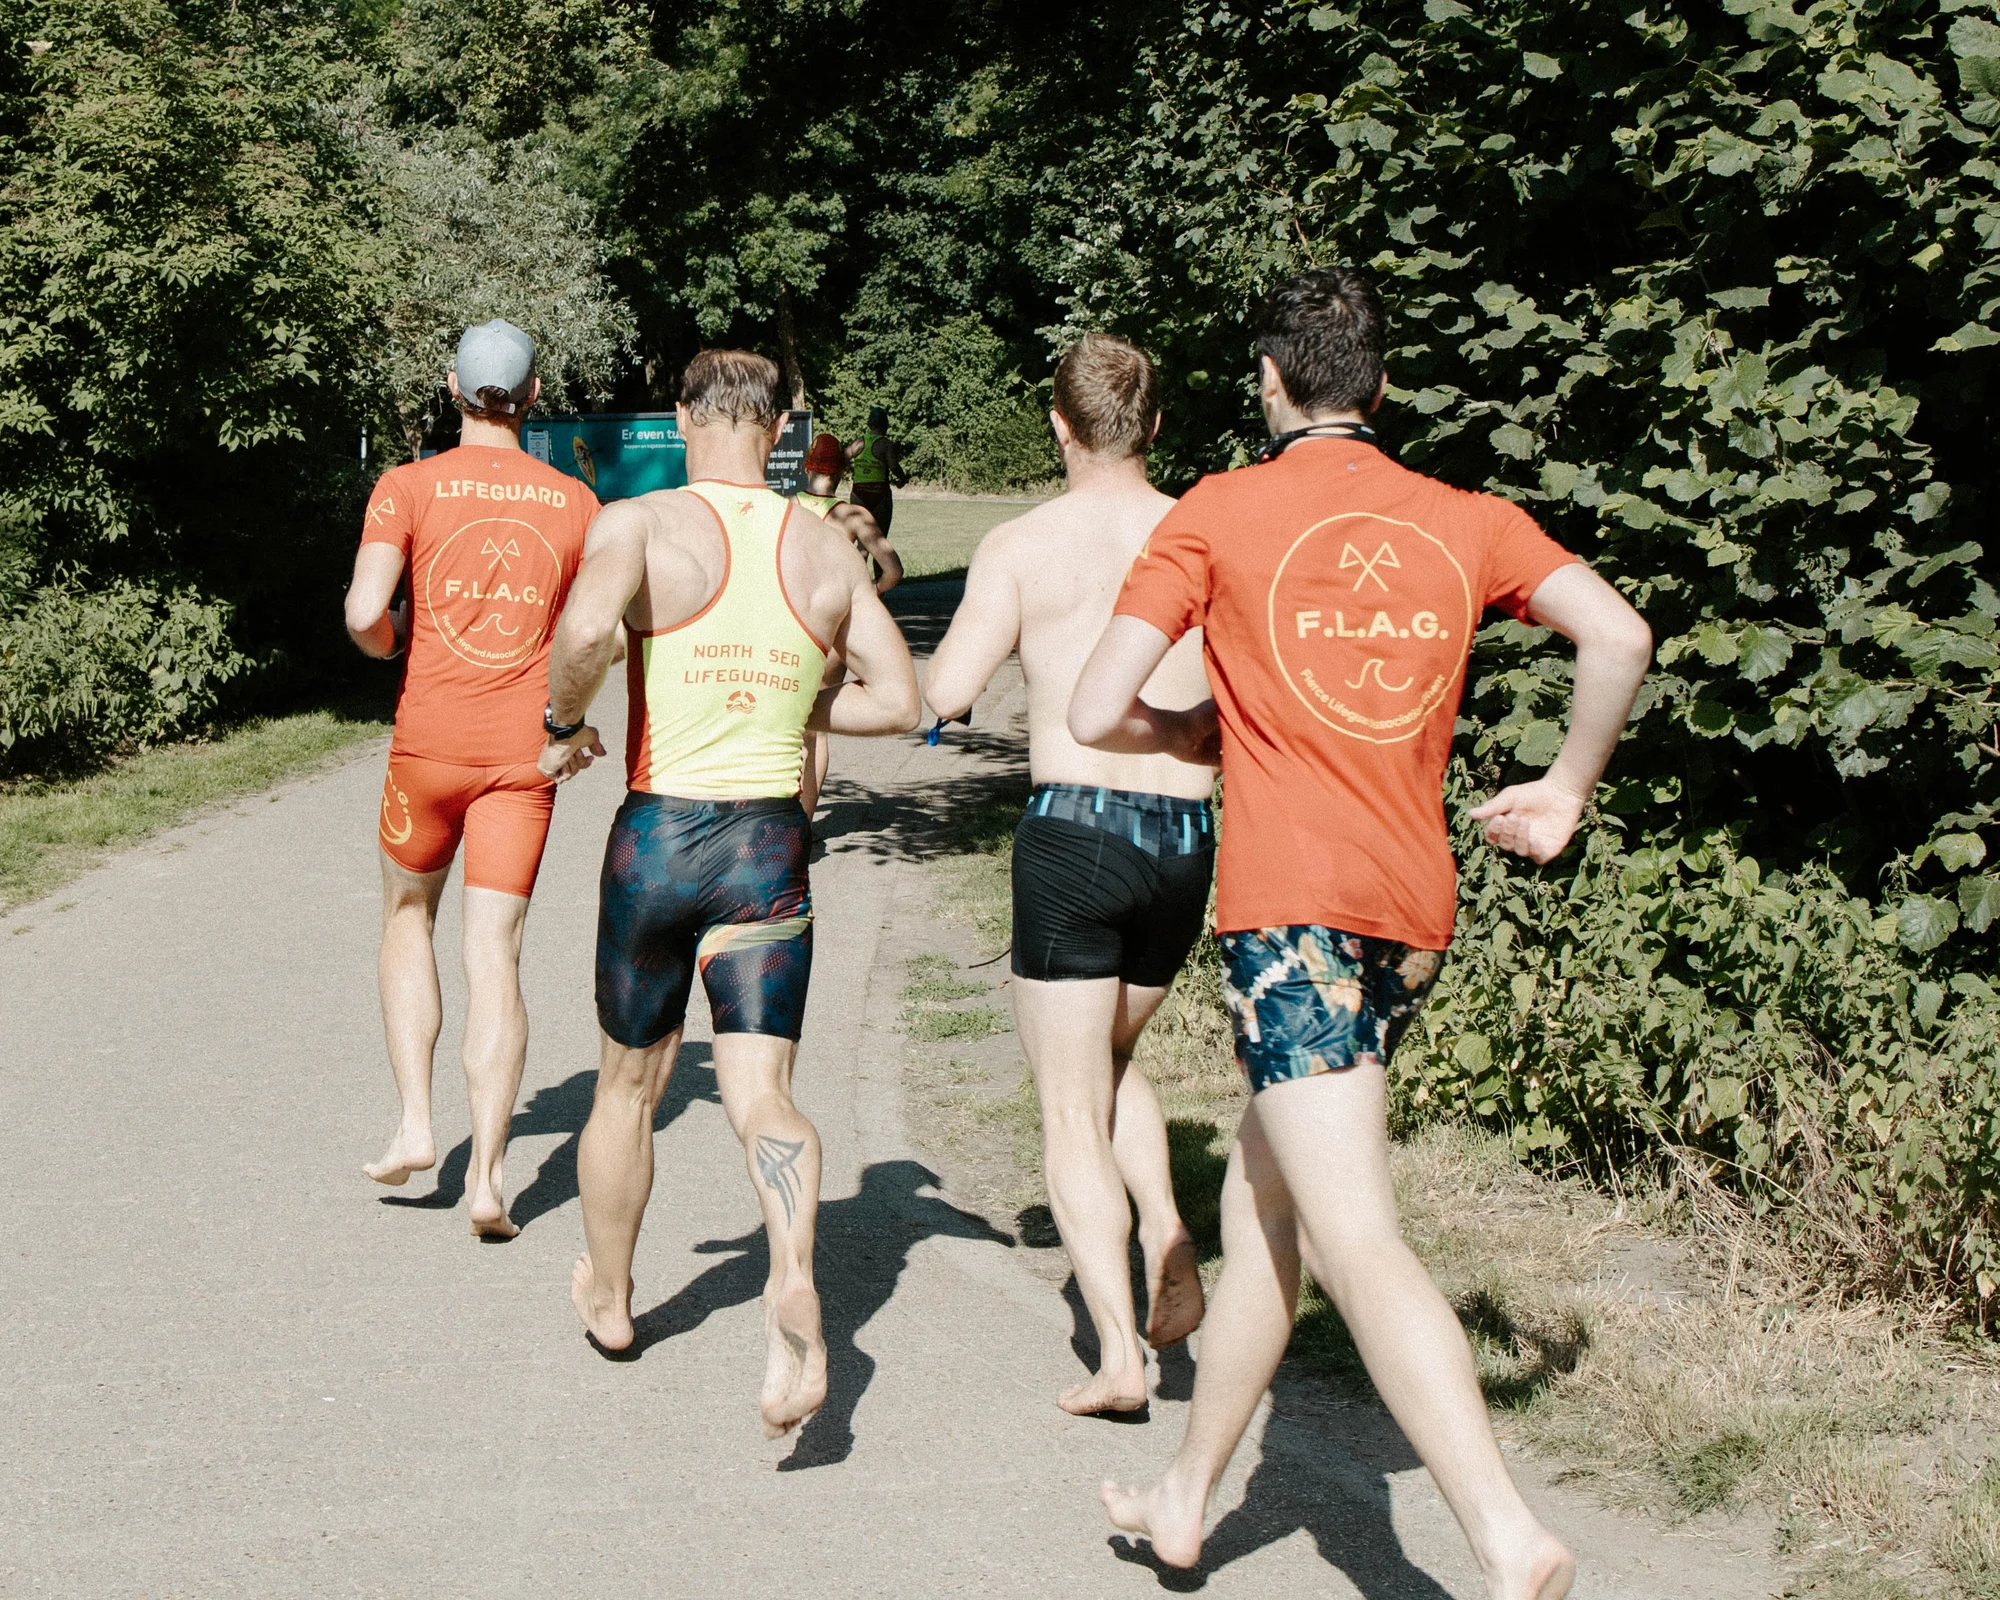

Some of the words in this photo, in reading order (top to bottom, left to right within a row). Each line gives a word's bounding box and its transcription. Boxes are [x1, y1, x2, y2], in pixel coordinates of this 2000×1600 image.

[621, 429, 634, 440] Er
[636, 430, 664, 440] even
[435, 479, 566, 509] LIFEGUARD
[445, 580, 545, 606] F.L.A.G.
[1296, 610, 1449, 640] F.L.A.G.
[486, 645, 526, 660] Association
[525, 627, 542, 646] Ghent
[693, 645, 752, 659] NORTH
[769, 649, 800, 668] SEA
[684, 669, 800, 693] LIFEGUARDS
